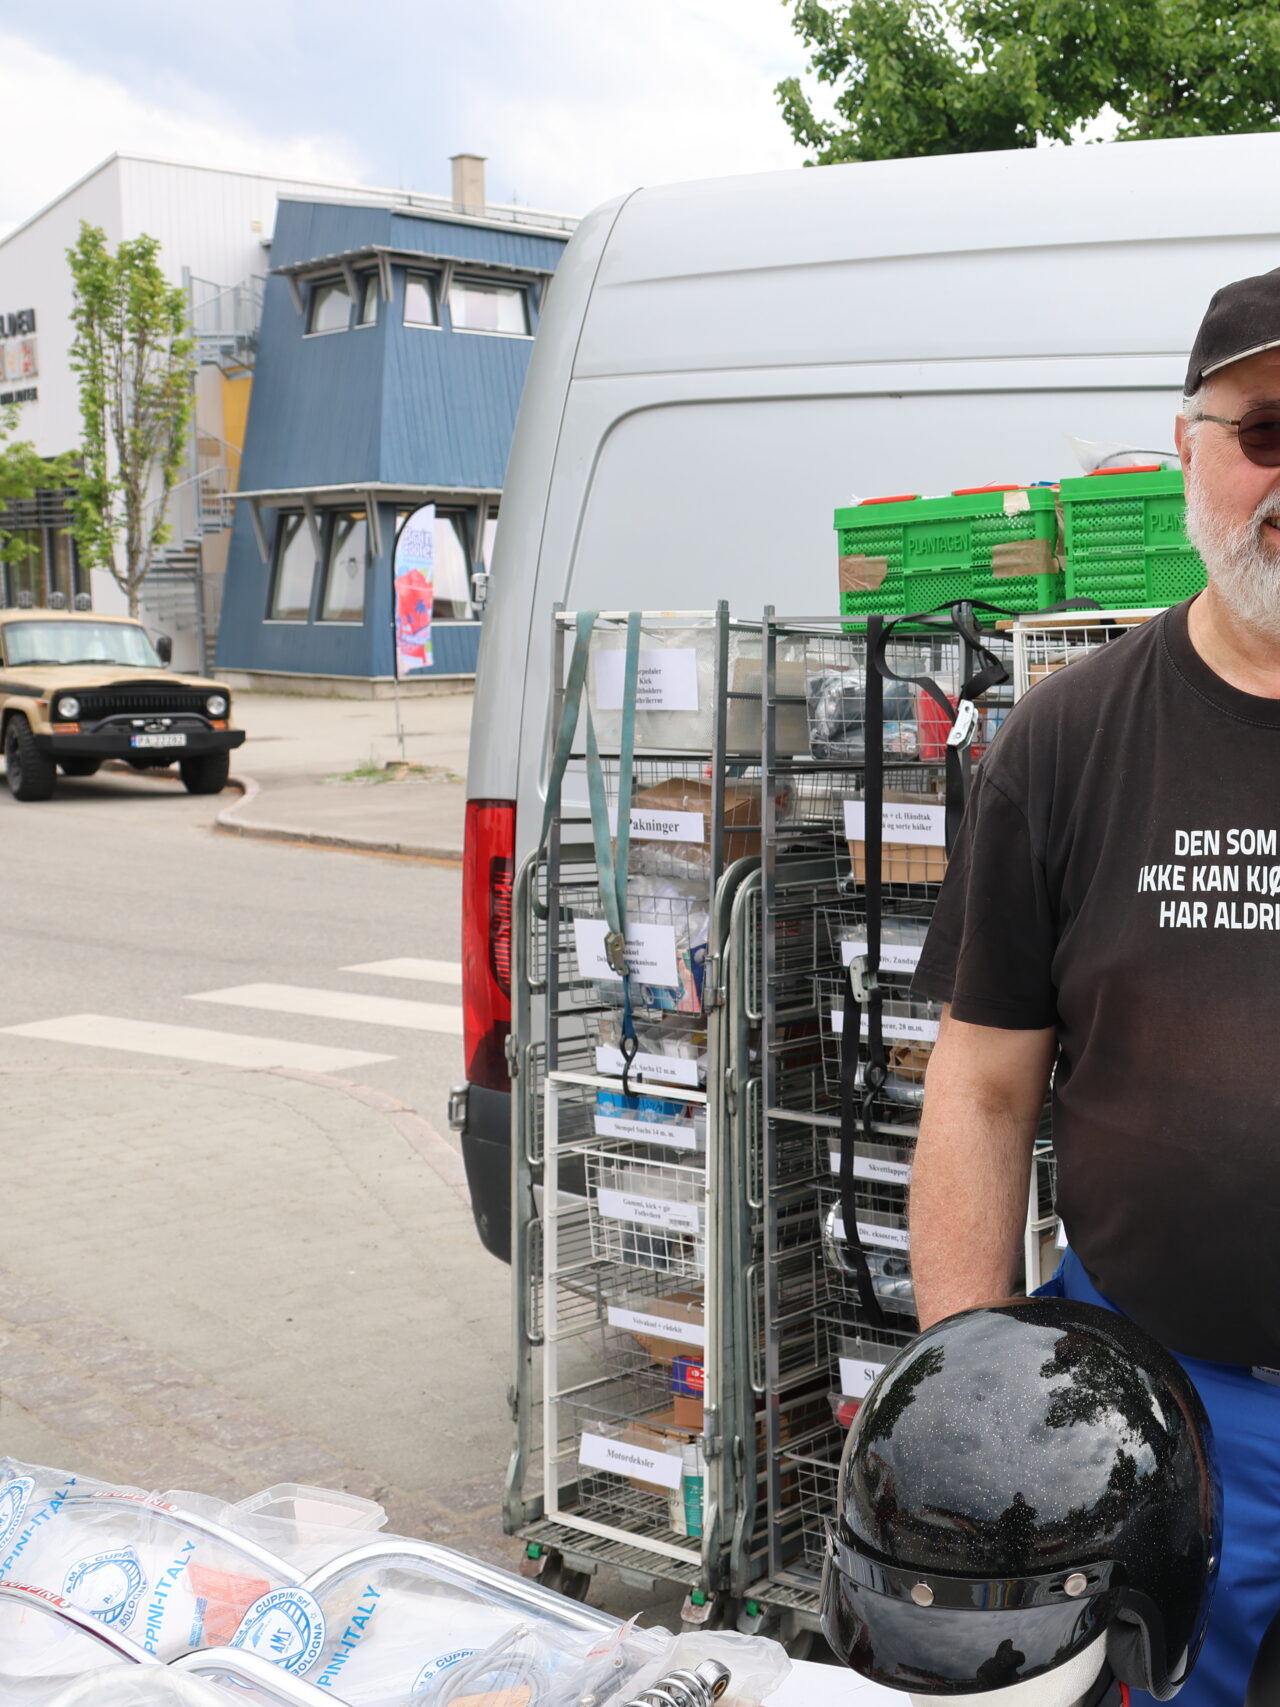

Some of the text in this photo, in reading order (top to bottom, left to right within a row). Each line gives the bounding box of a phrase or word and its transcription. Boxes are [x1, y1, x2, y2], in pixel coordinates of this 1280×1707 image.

[908, 533, 970, 557] PLANTAGEN
[1175, 829, 1220, 857] DEN
[1226, 829, 1277, 856] SOM
[1137, 864, 1186, 893] IKKE
[1192, 865, 1239, 892] KAN
[1159, 901, 1207, 928] HAR
[1214, 901, 1280, 930] ALDRI
[607, 1448, 655, 1470] Motordeksler
[145, 1538, 196, 1656] PPINI-ITALY
[316, 1584, 382, 1687] PINI-ITALY
